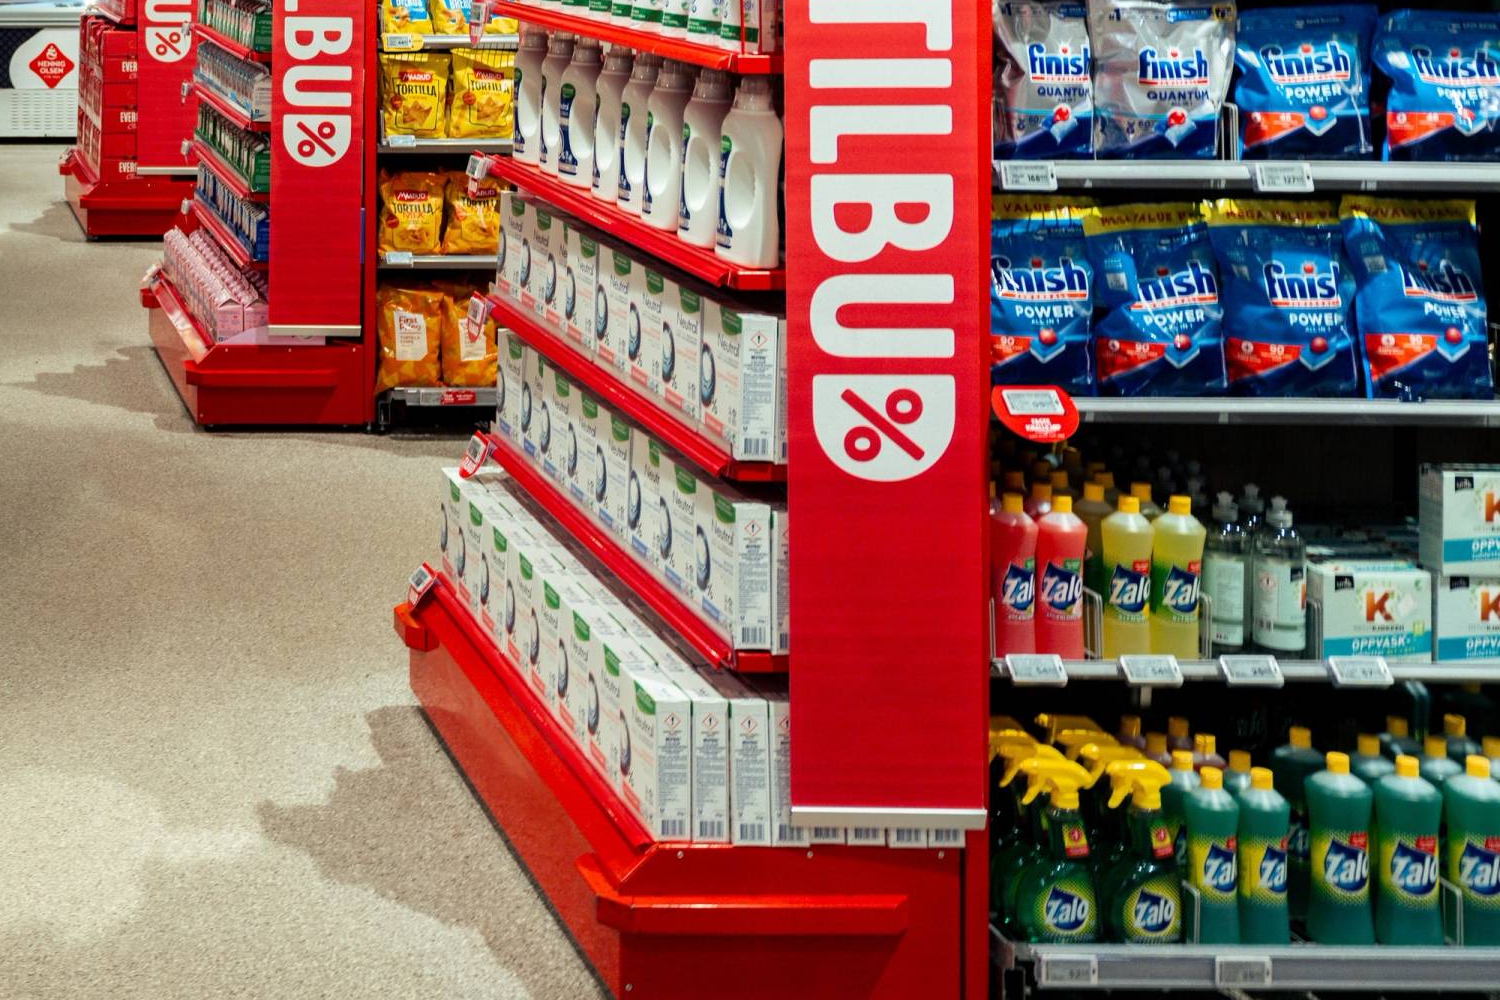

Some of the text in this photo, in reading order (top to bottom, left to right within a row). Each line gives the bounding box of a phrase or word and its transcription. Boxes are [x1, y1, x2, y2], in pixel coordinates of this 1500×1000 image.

[37, 60, 66, 68] HENNIG
[1138, 45, 1209, 80] finish
[1261, 41, 1351, 78] finish
[1411, 46, 1500, 80] finish
[39, 67, 64, 75] OLSEN
[403, 72, 432, 82] MAARUD
[395, 83, 438, 98] TORTILLA
[469, 79, 514, 94] TORTILLA
[1146, 88, 1210, 101] QUANTUM
[1285, 84, 1342, 100] POWER
[1436, 86, 1489, 101] POWER
[396, 191, 427, 201] MAARUD
[391, 201, 434, 215] TORTILLA
[1003, 201, 1046, 213] VALUE
[1015, 303, 1075, 319] POWER
[1143, 308, 1206, 328] POWER
[1424, 302, 1467, 319] POWER
[676, 311, 699, 335] Neutral
[717, 334, 741, 358] Neutral
[1000, 336, 1015, 346] 90
[1135, 343, 1150, 353] 90
[1409, 335, 1423, 345] 90
[1269, 345, 1285, 355] 90
[710, 518, 735, 549] Neutral
[1041, 574, 1084, 605] Zalo
[1365, 589, 1395, 623] K
[1391, 856, 1440, 888] Zalo
[1046, 895, 1090, 926] Zalo
[1133, 896, 1176, 928] Zalo
